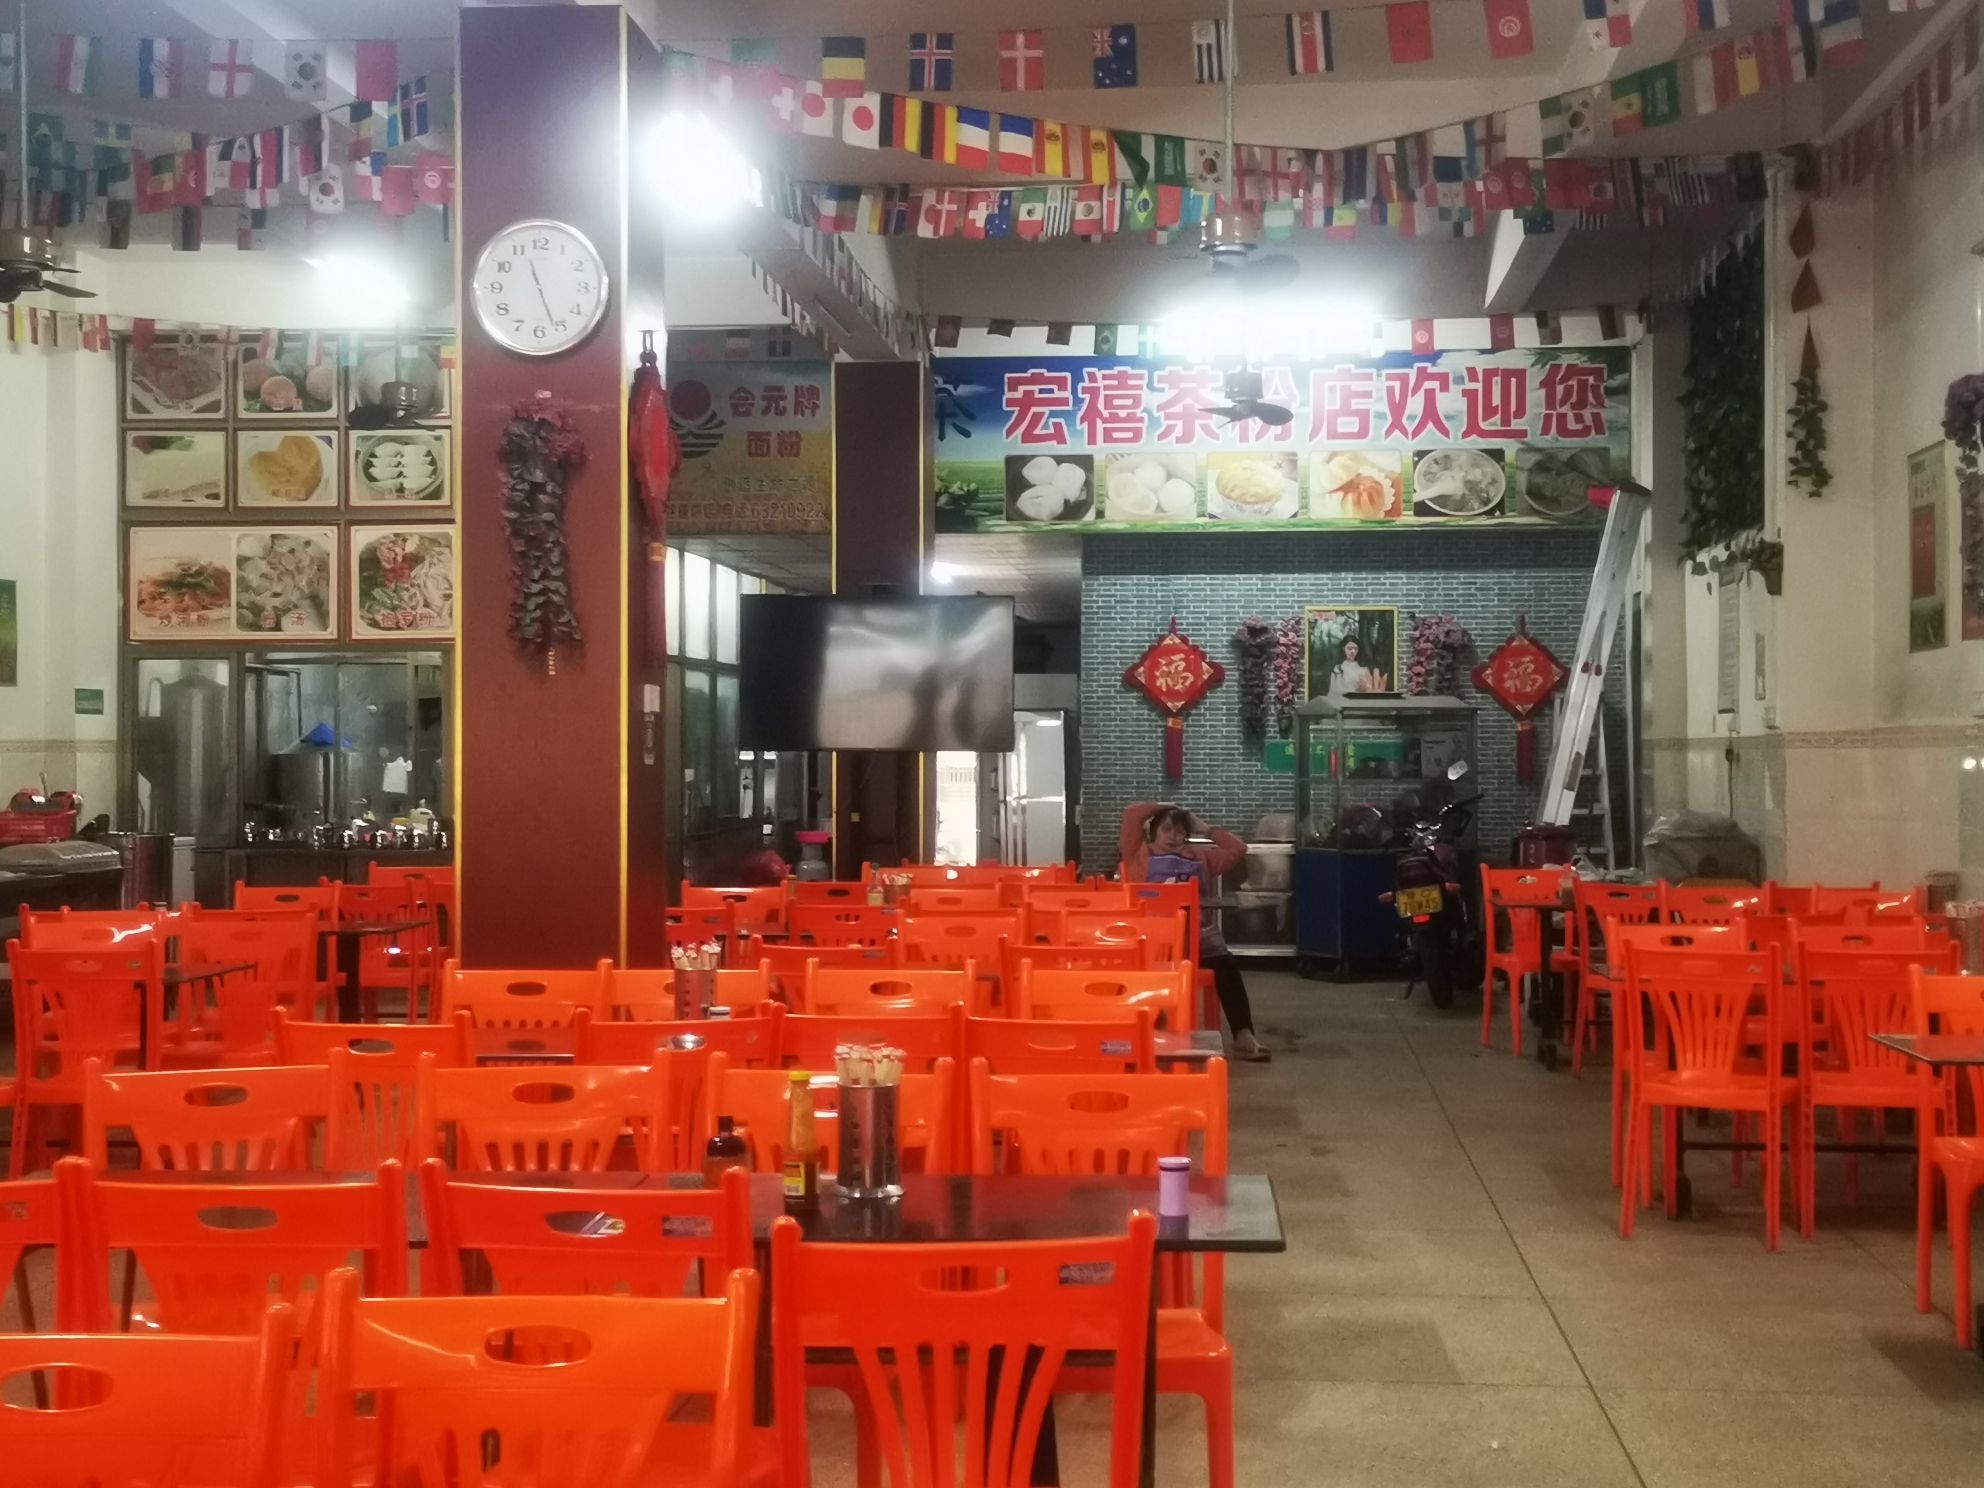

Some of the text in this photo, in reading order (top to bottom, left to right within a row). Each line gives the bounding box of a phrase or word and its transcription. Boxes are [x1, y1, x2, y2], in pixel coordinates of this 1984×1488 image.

[511, 244, 525, 256] 11
[531, 237, 550, 251] 12
[496, 261, 512, 273] 10
[571, 259, 584, 272] 2
[489, 281, 504, 294] 9
[576, 282, 590, 295] 3
[495, 303, 510, 316] 8
[569, 303, 582, 316] 4
[512, 319, 525, 332] 7
[532, 325, 547, 339] 6
[554, 320, 568, 333] 5
[1153, 653, 1195, 693] 福
[1503, 656, 1543, 694] 福
